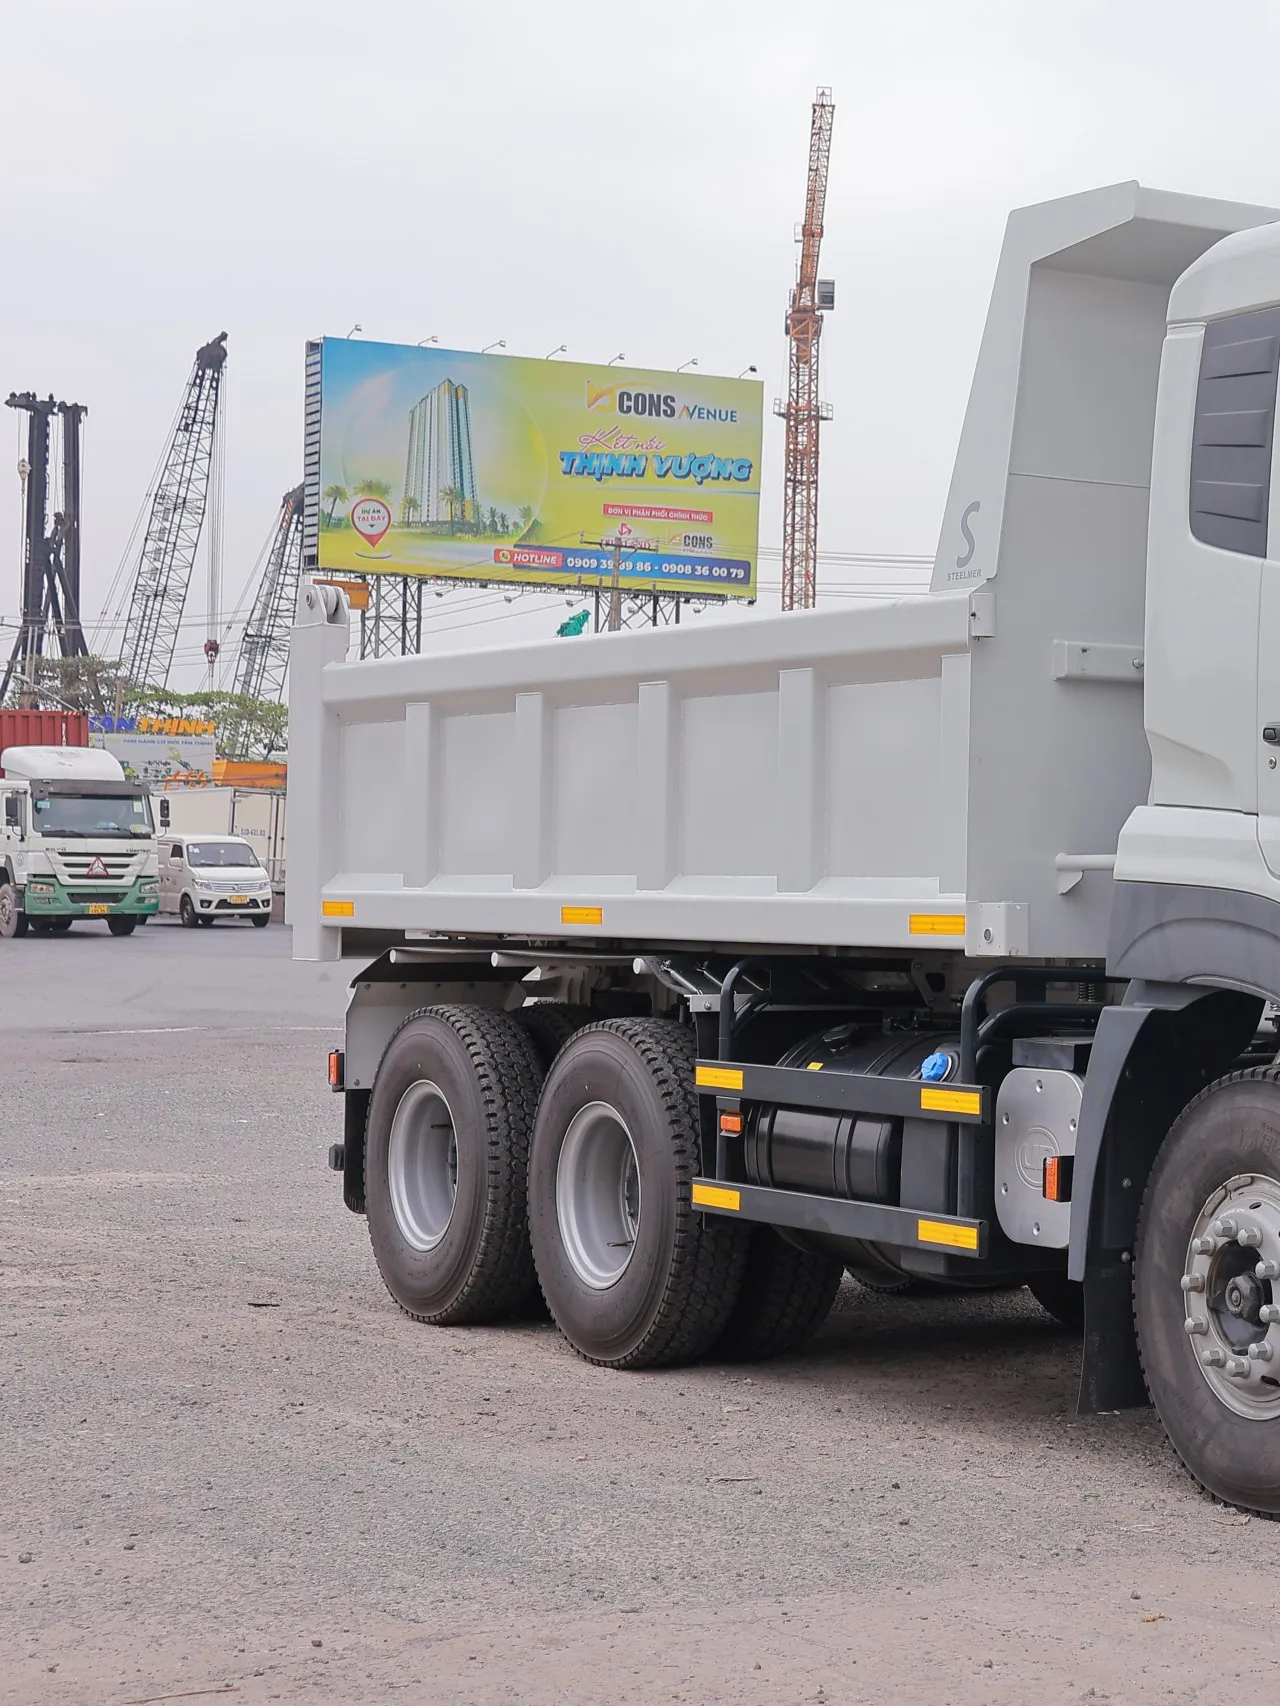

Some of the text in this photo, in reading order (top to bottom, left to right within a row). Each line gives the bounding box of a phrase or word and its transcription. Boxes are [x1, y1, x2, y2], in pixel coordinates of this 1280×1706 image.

[559, 451, 753, 485] THỊNH VƯỢNG
[513, 552, 558, 564] HOTLINE
[566, 556, 598, 569] 0909
[662, 562, 693, 575] 0908
[695, 565, 710, 577] 36
[712, 566, 728, 578] 00
[730, 568, 745, 579] 79
[137, 716, 216, 736] THỊNH
